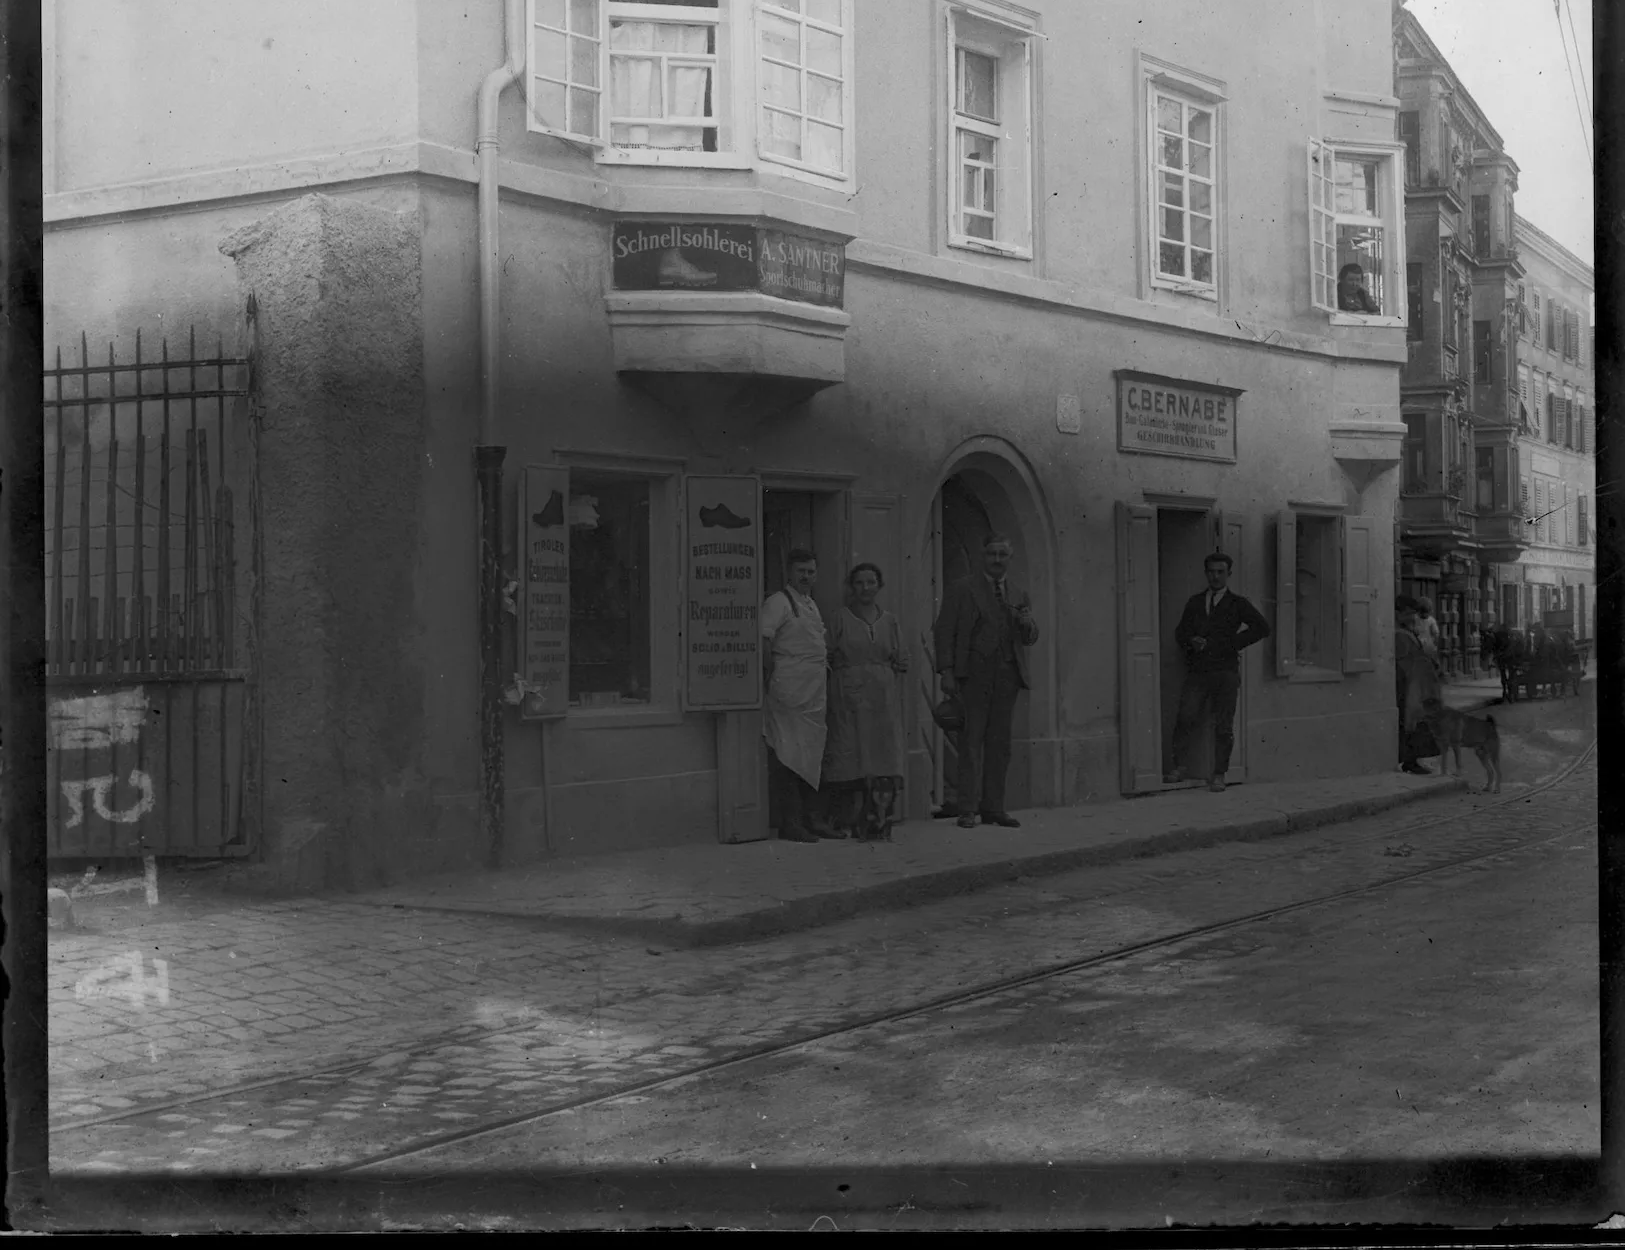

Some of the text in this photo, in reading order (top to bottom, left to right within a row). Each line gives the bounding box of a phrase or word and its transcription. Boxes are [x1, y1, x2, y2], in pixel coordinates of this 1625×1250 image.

[615, 226, 753, 262] Schnellsohlerei
[760, 238, 840, 275] A. SANTNER
[533, 538, 565, 555] TIROLER
[692, 542, 755, 559] BESTELLUNGEN
[695, 565, 752, 580] NACH MASS
[690, 600, 756, 626] Reparaturen
